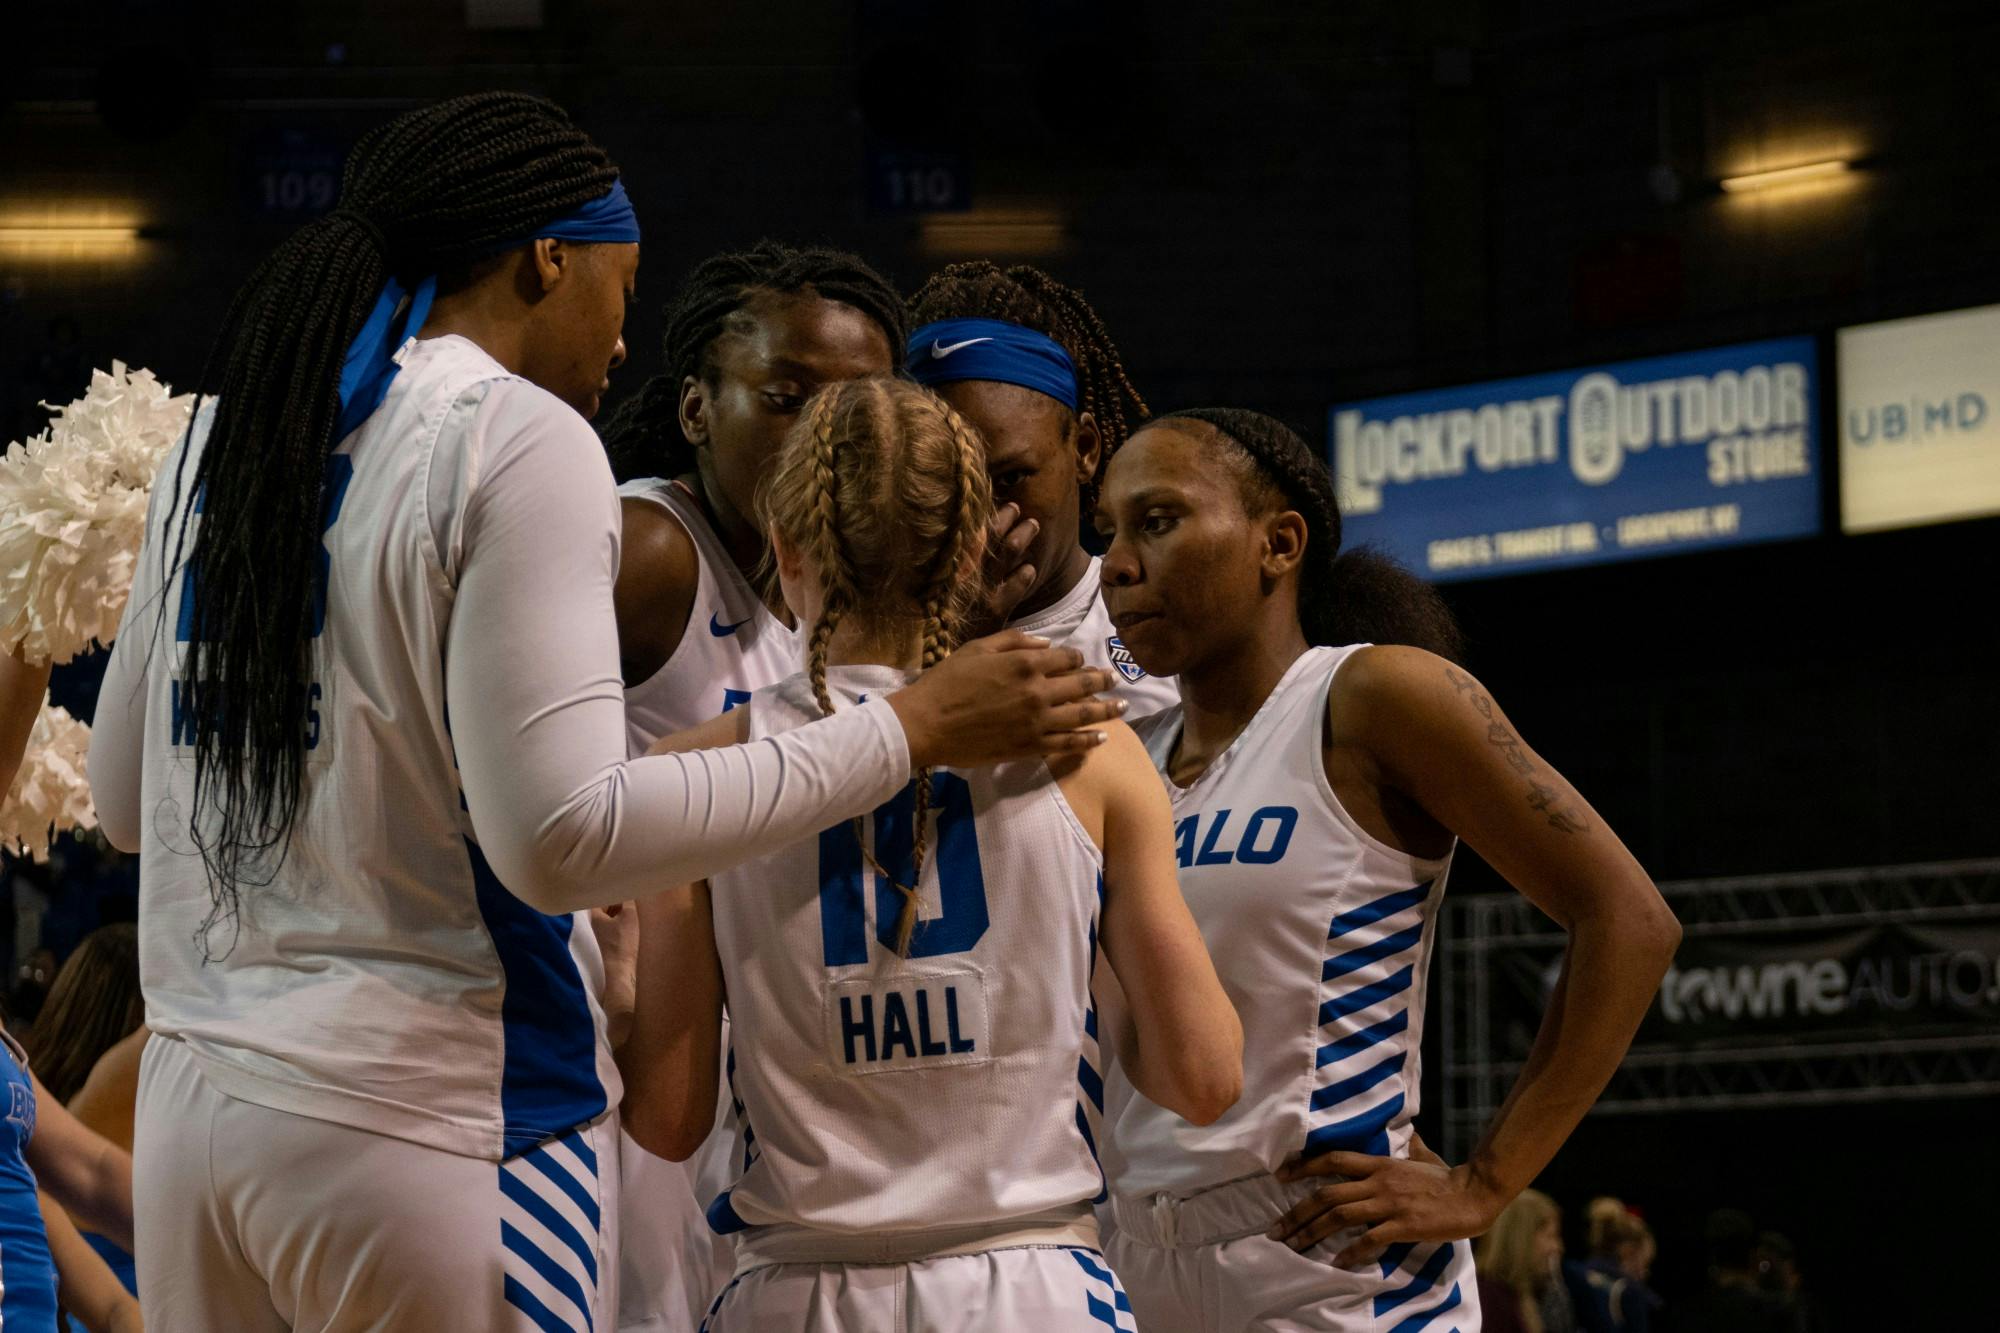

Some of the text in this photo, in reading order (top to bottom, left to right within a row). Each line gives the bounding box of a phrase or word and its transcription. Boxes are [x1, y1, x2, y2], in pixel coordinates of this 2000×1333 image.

[261, 171, 336, 209] 109
[888, 168, 957, 207] 110
[1334, 363, 1809, 516] LOCKPORT OUTDOOR
[1707, 427, 1809, 484] STORE
[820, 770, 989, 967] 10
[840, 986, 975, 1065] HALL
